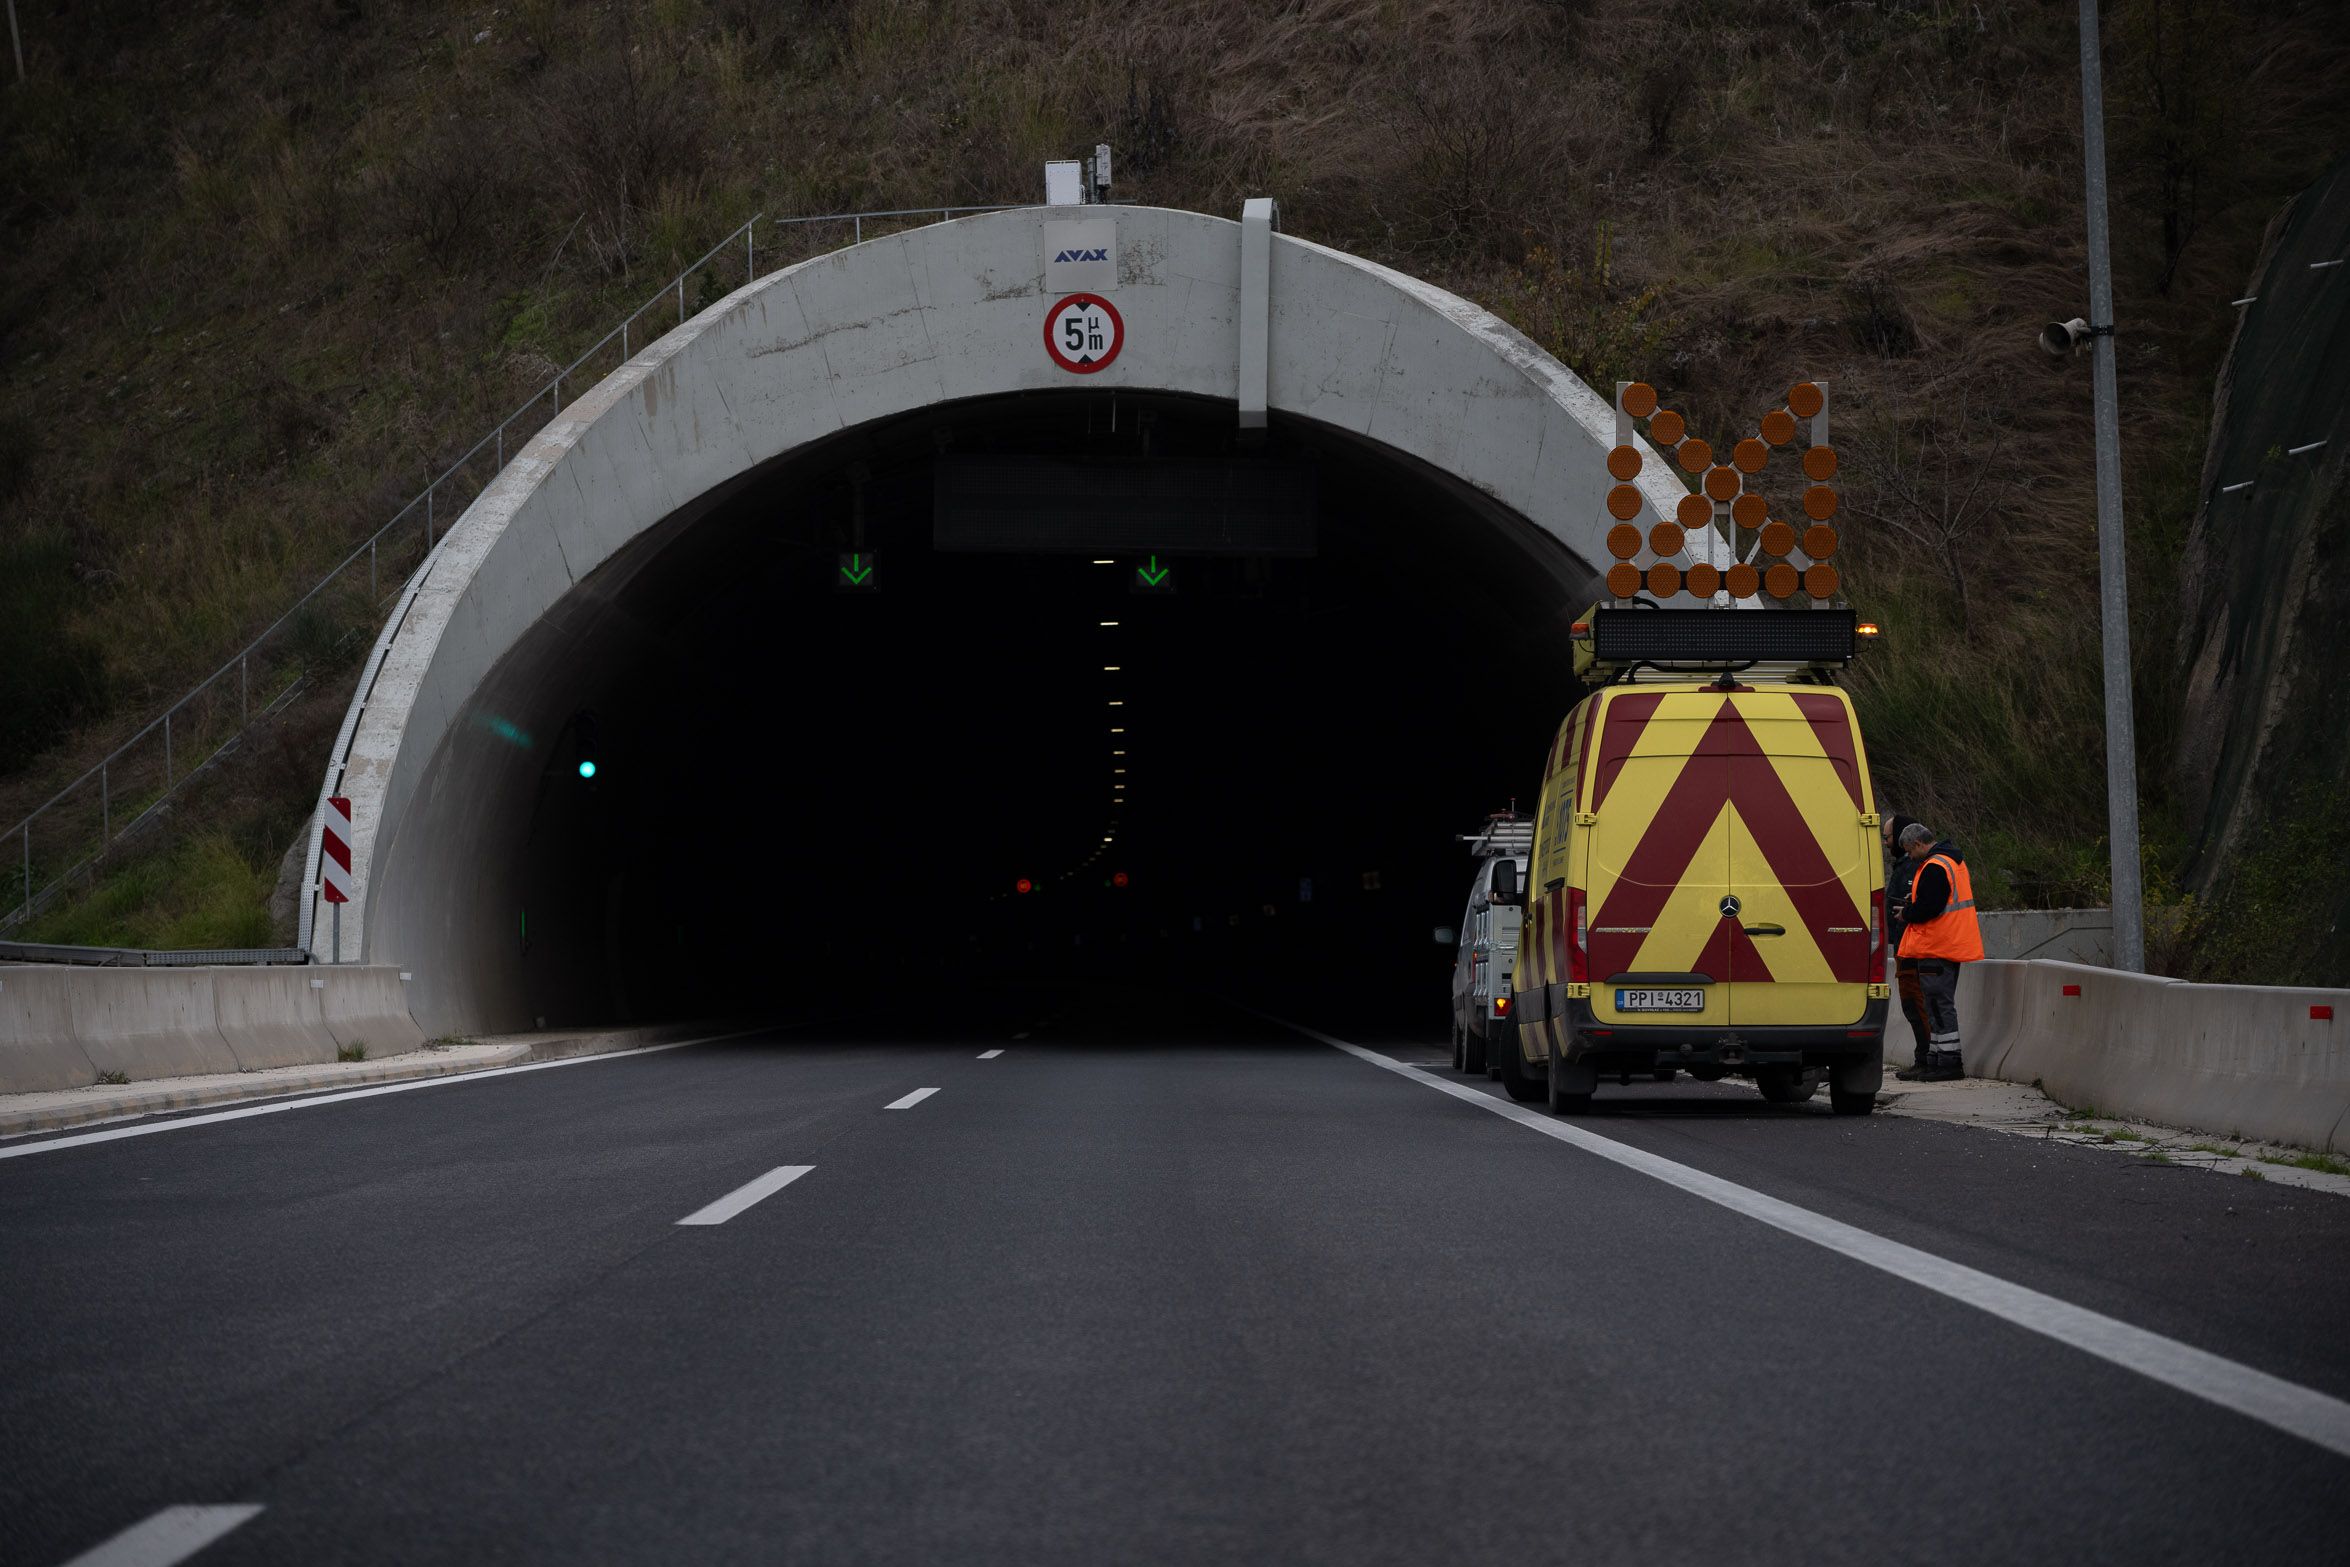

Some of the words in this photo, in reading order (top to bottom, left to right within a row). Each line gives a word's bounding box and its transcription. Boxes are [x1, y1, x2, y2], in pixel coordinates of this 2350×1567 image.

[1054, 249, 1108, 263] AVAX
[1065, 318, 1084, 351] 5
[1089, 334, 1103, 350] m
